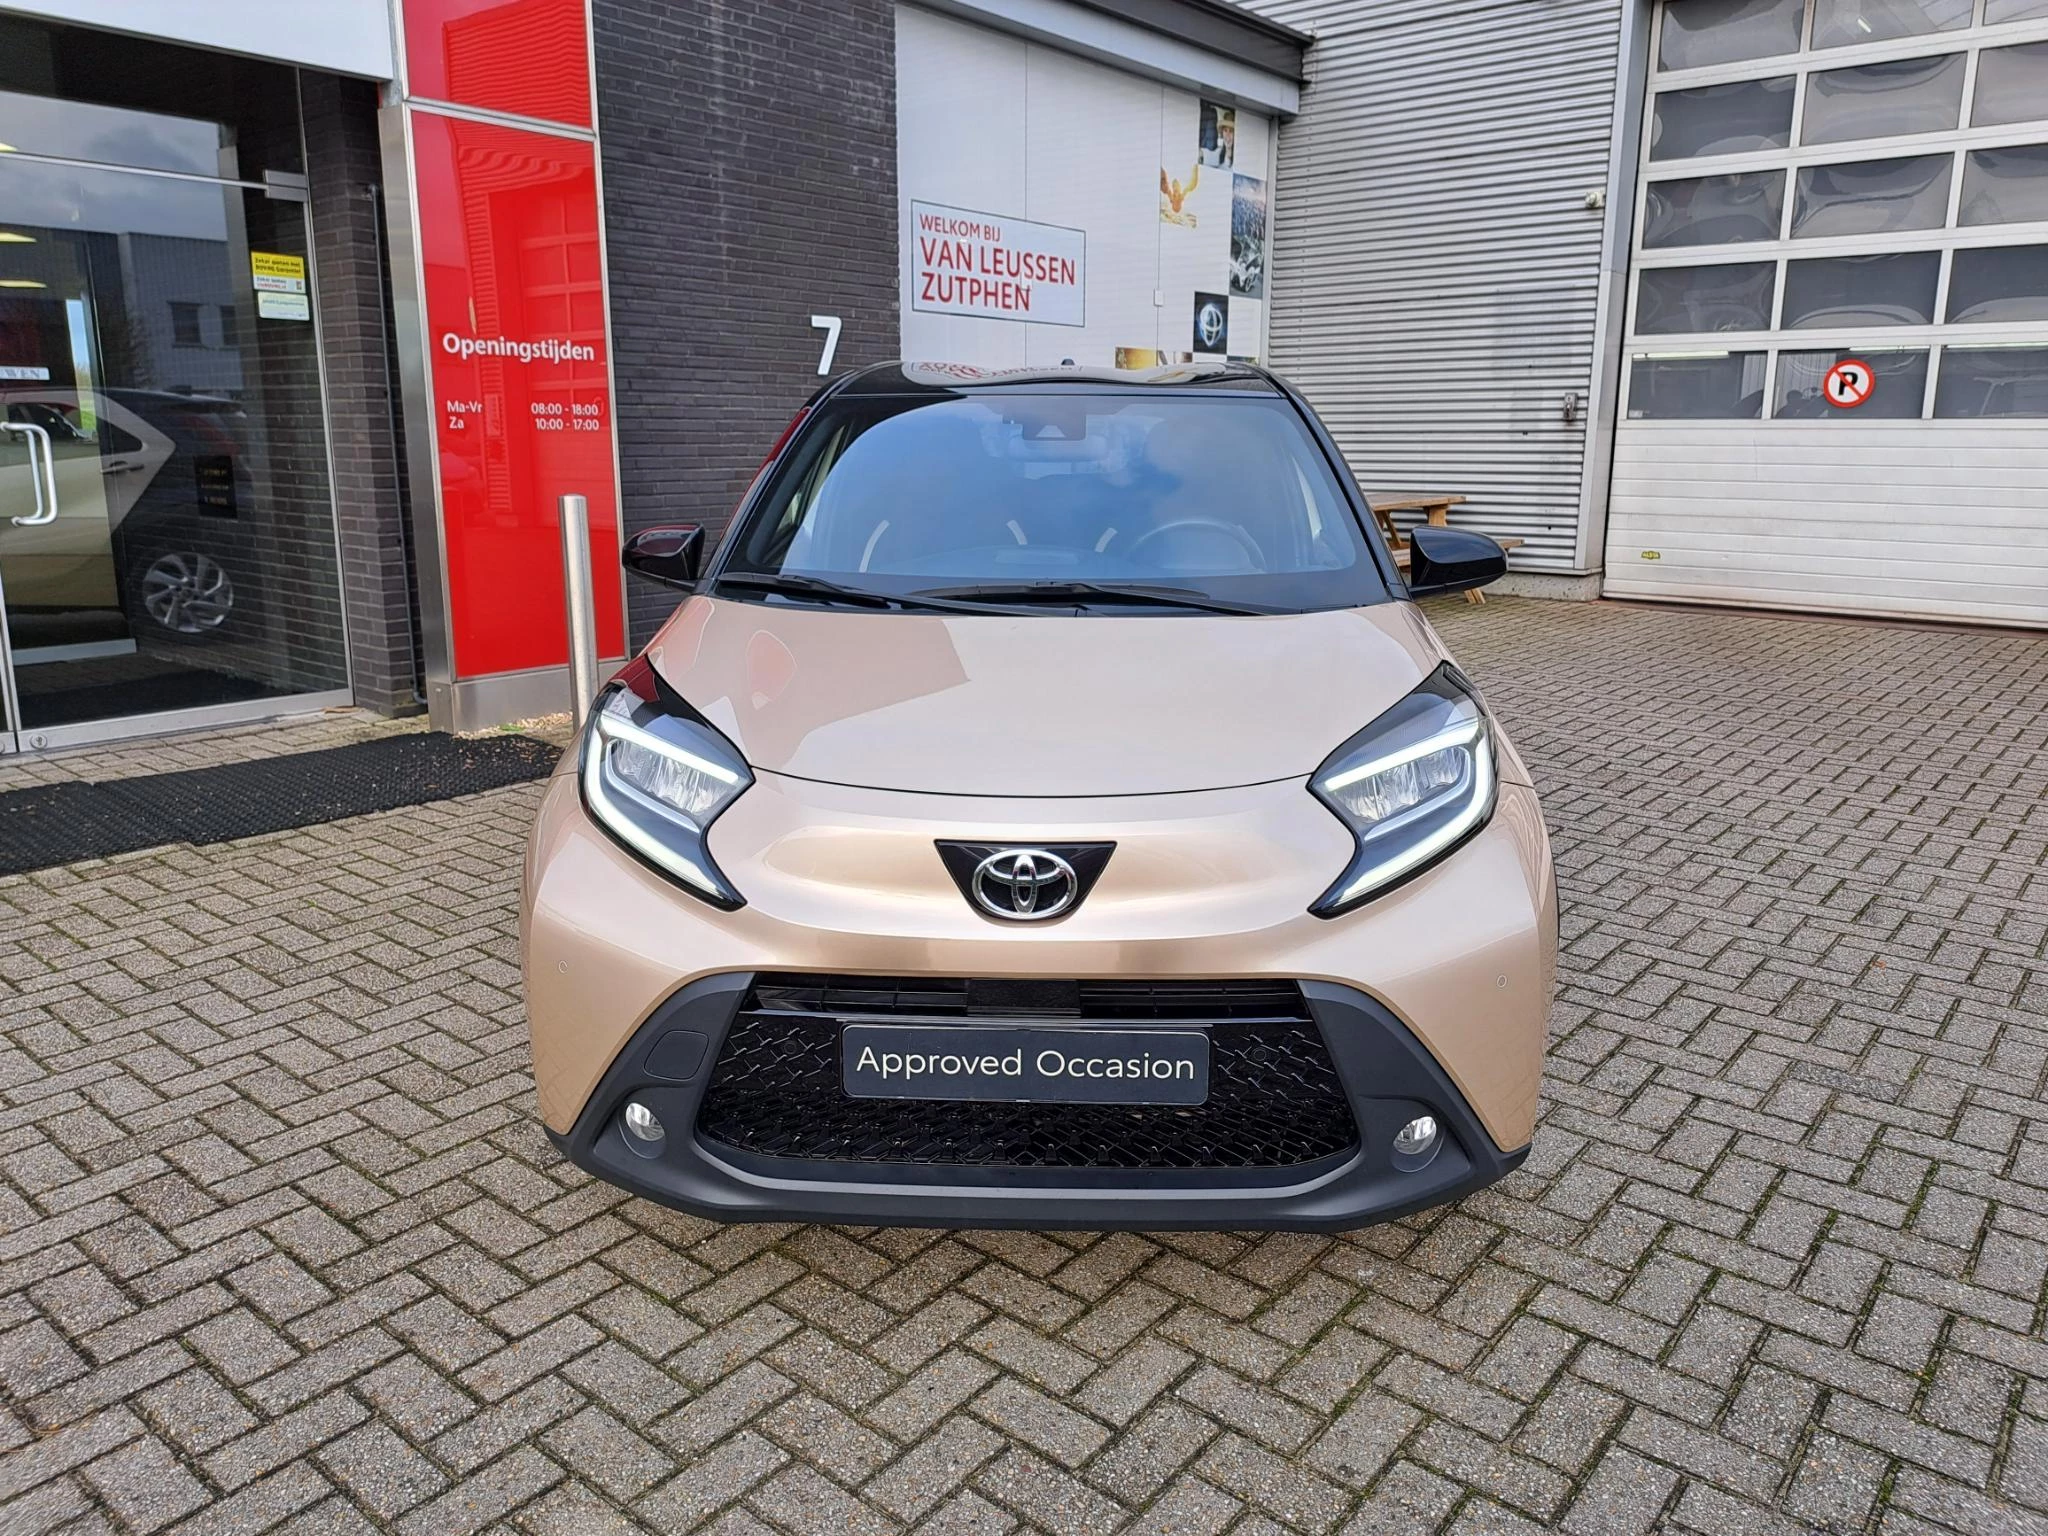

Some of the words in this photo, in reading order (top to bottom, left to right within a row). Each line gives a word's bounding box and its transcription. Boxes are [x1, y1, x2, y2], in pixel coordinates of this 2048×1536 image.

[920, 213, 980, 239] WELKOM
[984, 224, 1001, 243] BIJ
[920, 236, 973, 272] VAN
[980, 245, 1075, 286] LEUSSEN
[921, 272, 1031, 312] ZUTPHEN
[442, 332, 595, 364] Openingstijden
[811, 315, 842, 376] 7
[1838, 371, 1859, 396] P
[447, 400, 483, 413] Ma-Vr
[531, 402, 562, 415] 08:00
[571, 403, 599, 416] 18:00
[449, 416, 465, 429] Za
[535, 418, 564, 430] 10:00
[573, 418, 600, 430] 17:00
[856, 1046, 1022, 1080] Approved
[1036, 1050, 1195, 1080] Occasion
